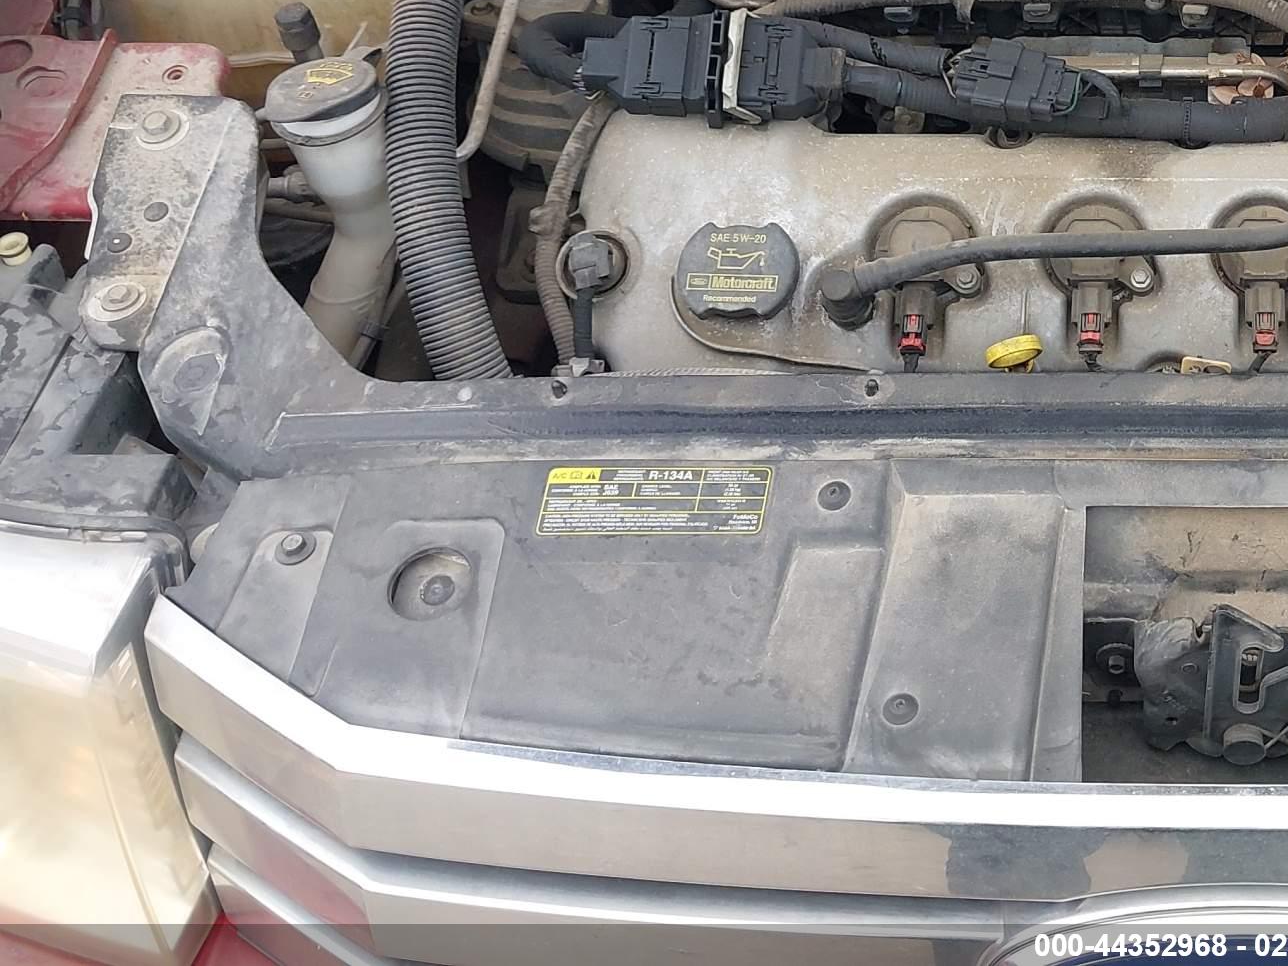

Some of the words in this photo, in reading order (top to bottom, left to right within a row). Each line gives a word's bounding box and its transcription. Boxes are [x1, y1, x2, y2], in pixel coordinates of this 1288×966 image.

[710, 233, 730, 242] SAE
[732, 234, 767, 243] 5W-20
[703, 294, 757, 303] Recommended
[648, 470, 693, 480] R-134A
